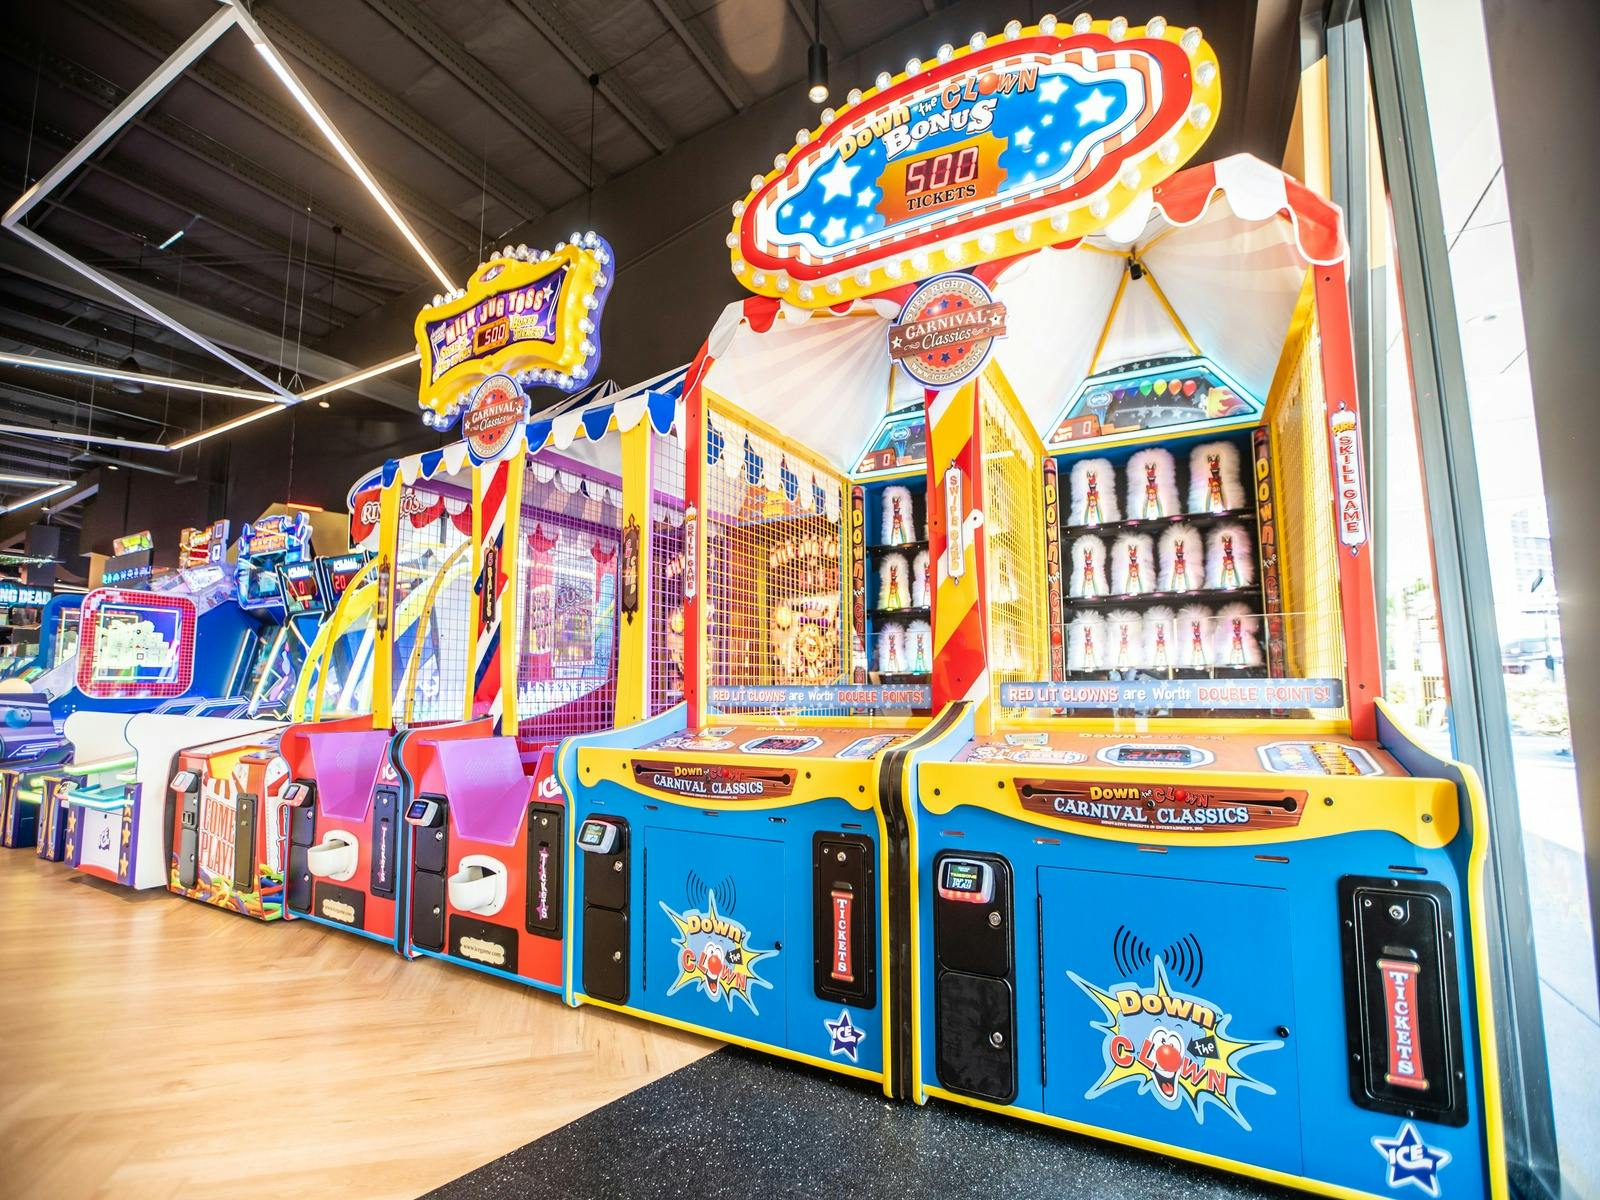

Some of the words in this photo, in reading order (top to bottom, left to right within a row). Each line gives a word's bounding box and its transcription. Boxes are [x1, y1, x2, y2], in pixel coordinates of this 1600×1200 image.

[918, 95, 938, 117] the
[940, 66, 1040, 110] CLOWN
[882, 98, 999, 161] BONUS
[906, 146, 978, 196] 500
[906, 184, 977, 211] TICKETS
[905, 291, 928, 321] STEP
[931, 279, 967, 294] RIGHT
[445, 306, 477, 346] MILK
[479, 296, 505, 324] JUG
[508, 287, 545, 314] TOSS
[905, 310, 987, 340] CARNIVAL
[484, 323, 505, 345] 500
[921, 327, 972, 351] Classics
[910, 348, 984, 381] WWW.ICEGAME.COM
[471, 401, 515, 423] CARNIVAL
[1339, 436, 1355, 484] SKILL
[949, 475, 959, 527] SWIPE
[1343, 489, 1361, 533] GAME
[19, 588, 52, 605] DEAD
[712, 689, 730, 701] RED
[732, 690, 746, 701] LIT
[748, 690, 786, 702] CLOWNS
[789, 691, 804, 701] are
[808, 690, 833, 701] Worth
[837, 690, 877, 703] DOUBLE
[1008, 687, 1034, 701] RED
[1037, 687, 1059, 702] LIT
[1062, 687, 1119, 703] CLOWNS
[1123, 688, 1146, 700] are
[1152, 686, 1191, 700] Worth
[1197, 687, 1257, 702] DOUBLE
[1265, 686, 1331, 702] POINTS!
[382, 763, 398, 780] IC
[653, 774, 706, 794] CARNIVAL
[711, 781, 764, 795] CLASSICS
[1053, 797, 1148, 822] CARNIVAL
[1156, 806, 1249, 825] CLASSICS
[1154, 786, 1209, 808] CLOWN
[203, 797, 236, 845] COME
[540, 853, 549, 919] TICKETS
[836, 898, 848, 973] TICKETS
[681, 948, 747, 991] CLOWN
[728, 951, 742, 965] the
[832, 1025, 855, 1044] ICE
[1388, 970, 1415, 1076] TICKETS
[1194, 1040, 1216, 1055] the
[1109, 1034, 1228, 1095] CLOWN
[1388, 1144, 1434, 1170] ICE
